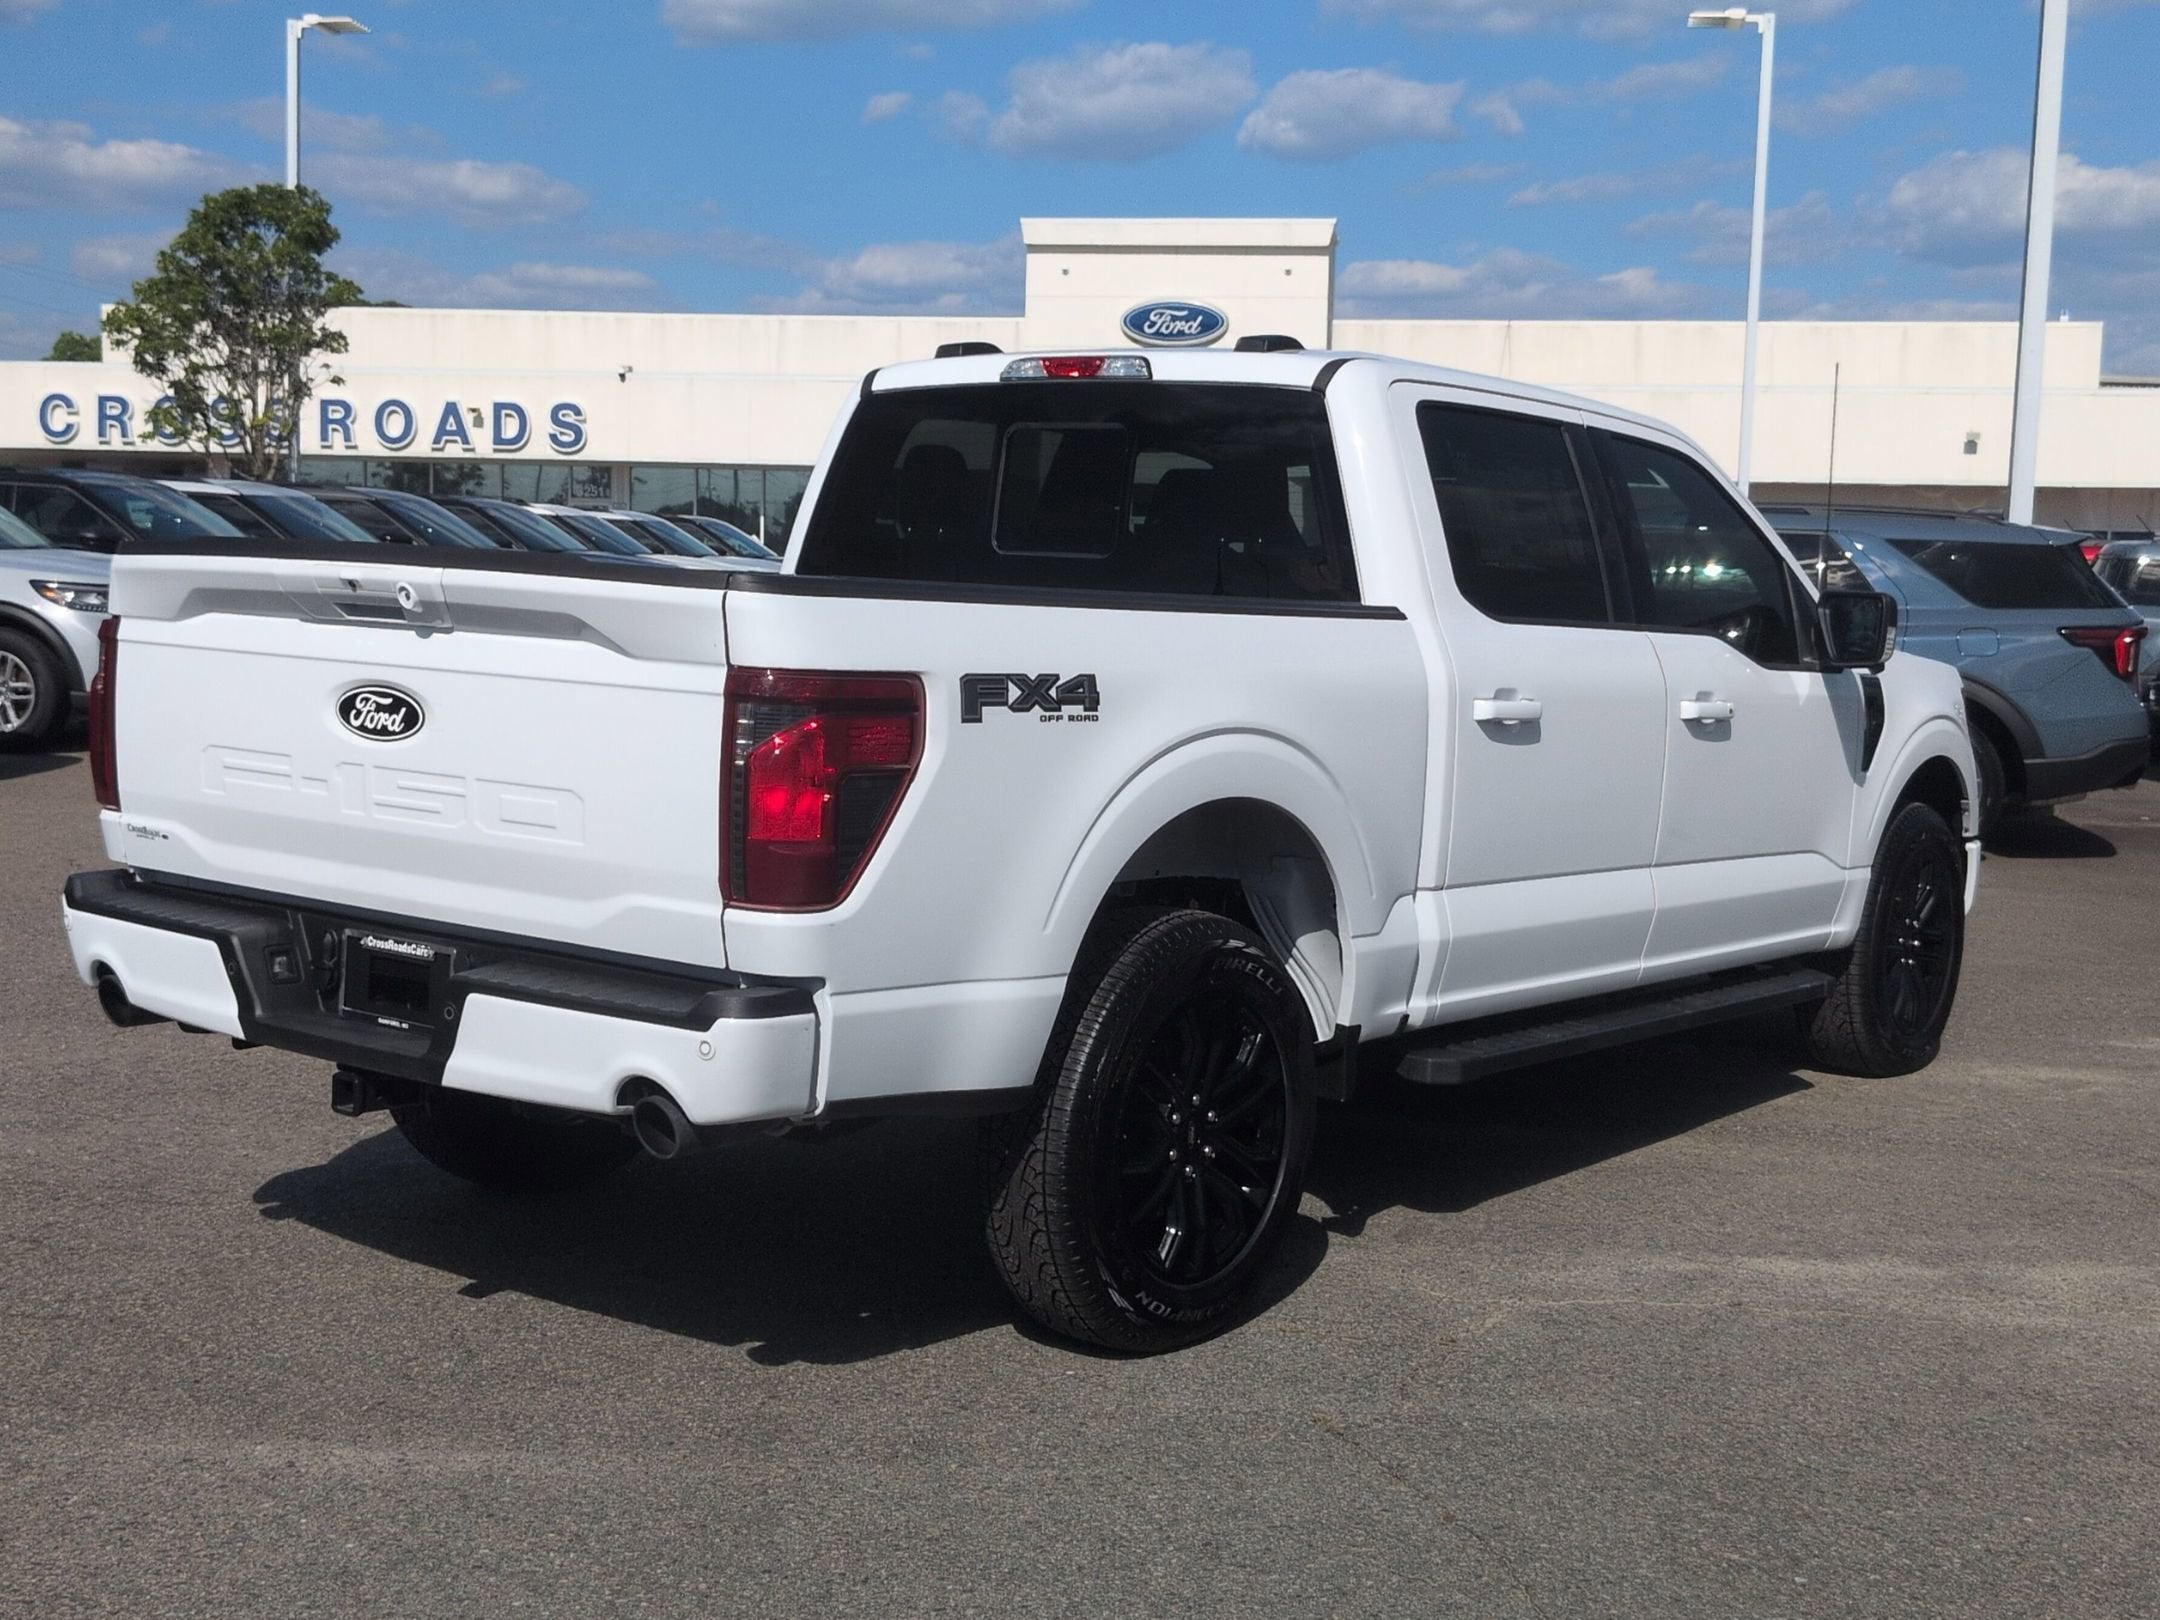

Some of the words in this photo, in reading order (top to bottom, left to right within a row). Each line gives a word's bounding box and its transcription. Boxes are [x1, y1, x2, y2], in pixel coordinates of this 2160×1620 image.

[1143, 308, 1203, 336] Ford
[349, 692, 407, 732] Ford
[959, 672, 1100, 724] FX4
[1039, 714, 1064, 723] OFF
[1067, 714, 1099, 722] ROAD
[201, 744, 586, 847] F-150
[1211, 957, 1283, 995] PIRELLI
